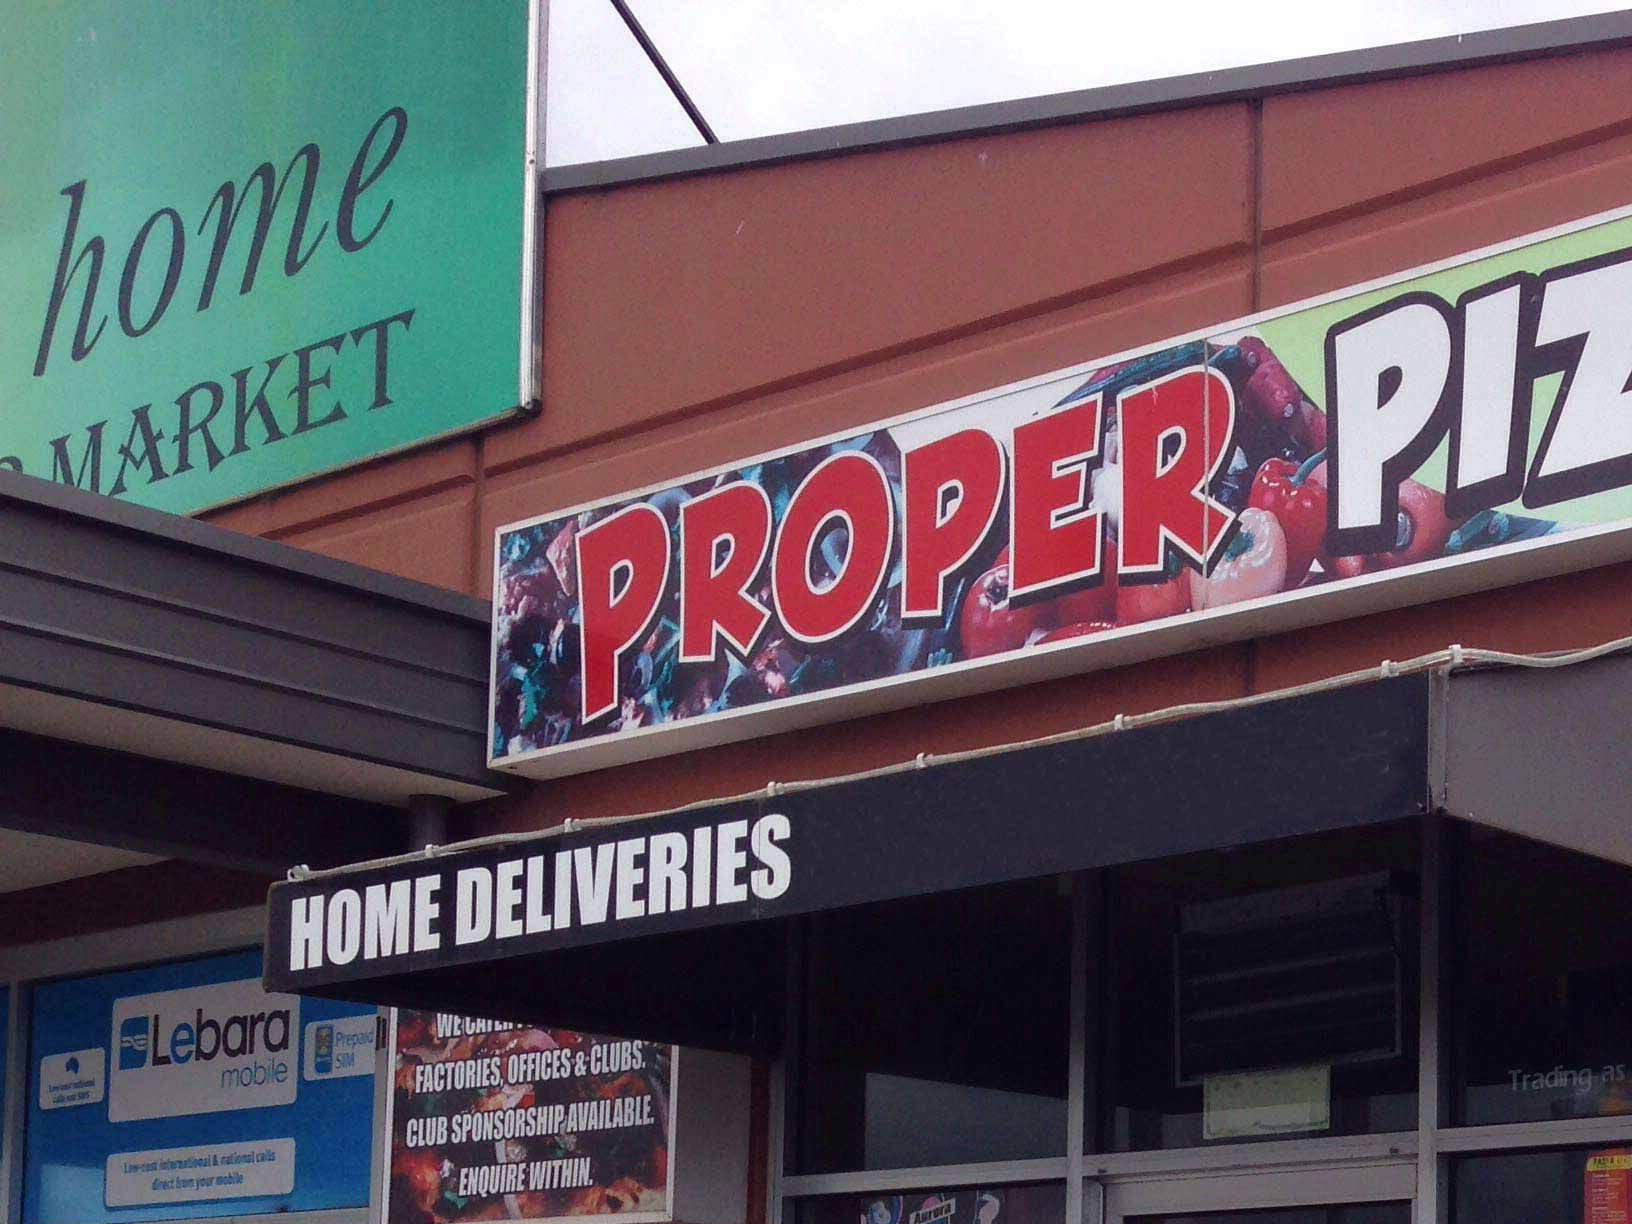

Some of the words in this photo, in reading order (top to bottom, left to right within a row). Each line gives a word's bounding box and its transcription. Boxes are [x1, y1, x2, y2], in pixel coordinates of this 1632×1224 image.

[33, 106, 409, 378] home
[574, 363, 1238, 726] PROPER
[289, 873, 441, 972] HOME
[454, 814, 792, 946] DELIVERIES
[151, 1008, 291, 1067] Lebara
[220, 1059, 289, 1090] mobile
[414, 1055, 504, 1094] FACTORIES,
[507, 1048, 572, 1085] OFFICES
[574, 1050, 587, 1077] &
[589, 1039, 647, 1076] CLUBS.
[1507, 1064, 1593, 1092] Trading
[1603, 1064, 1626, 1083] as
[405, 1114, 448, 1148] CLUB
[451, 1104, 567, 1144] SPONSORSHIP
[566, 1094, 655, 1134] AVAILABLE.
[457, 1162, 526, 1199] ENQUIRE
[528, 1156, 594, 1190] WITHIN.
